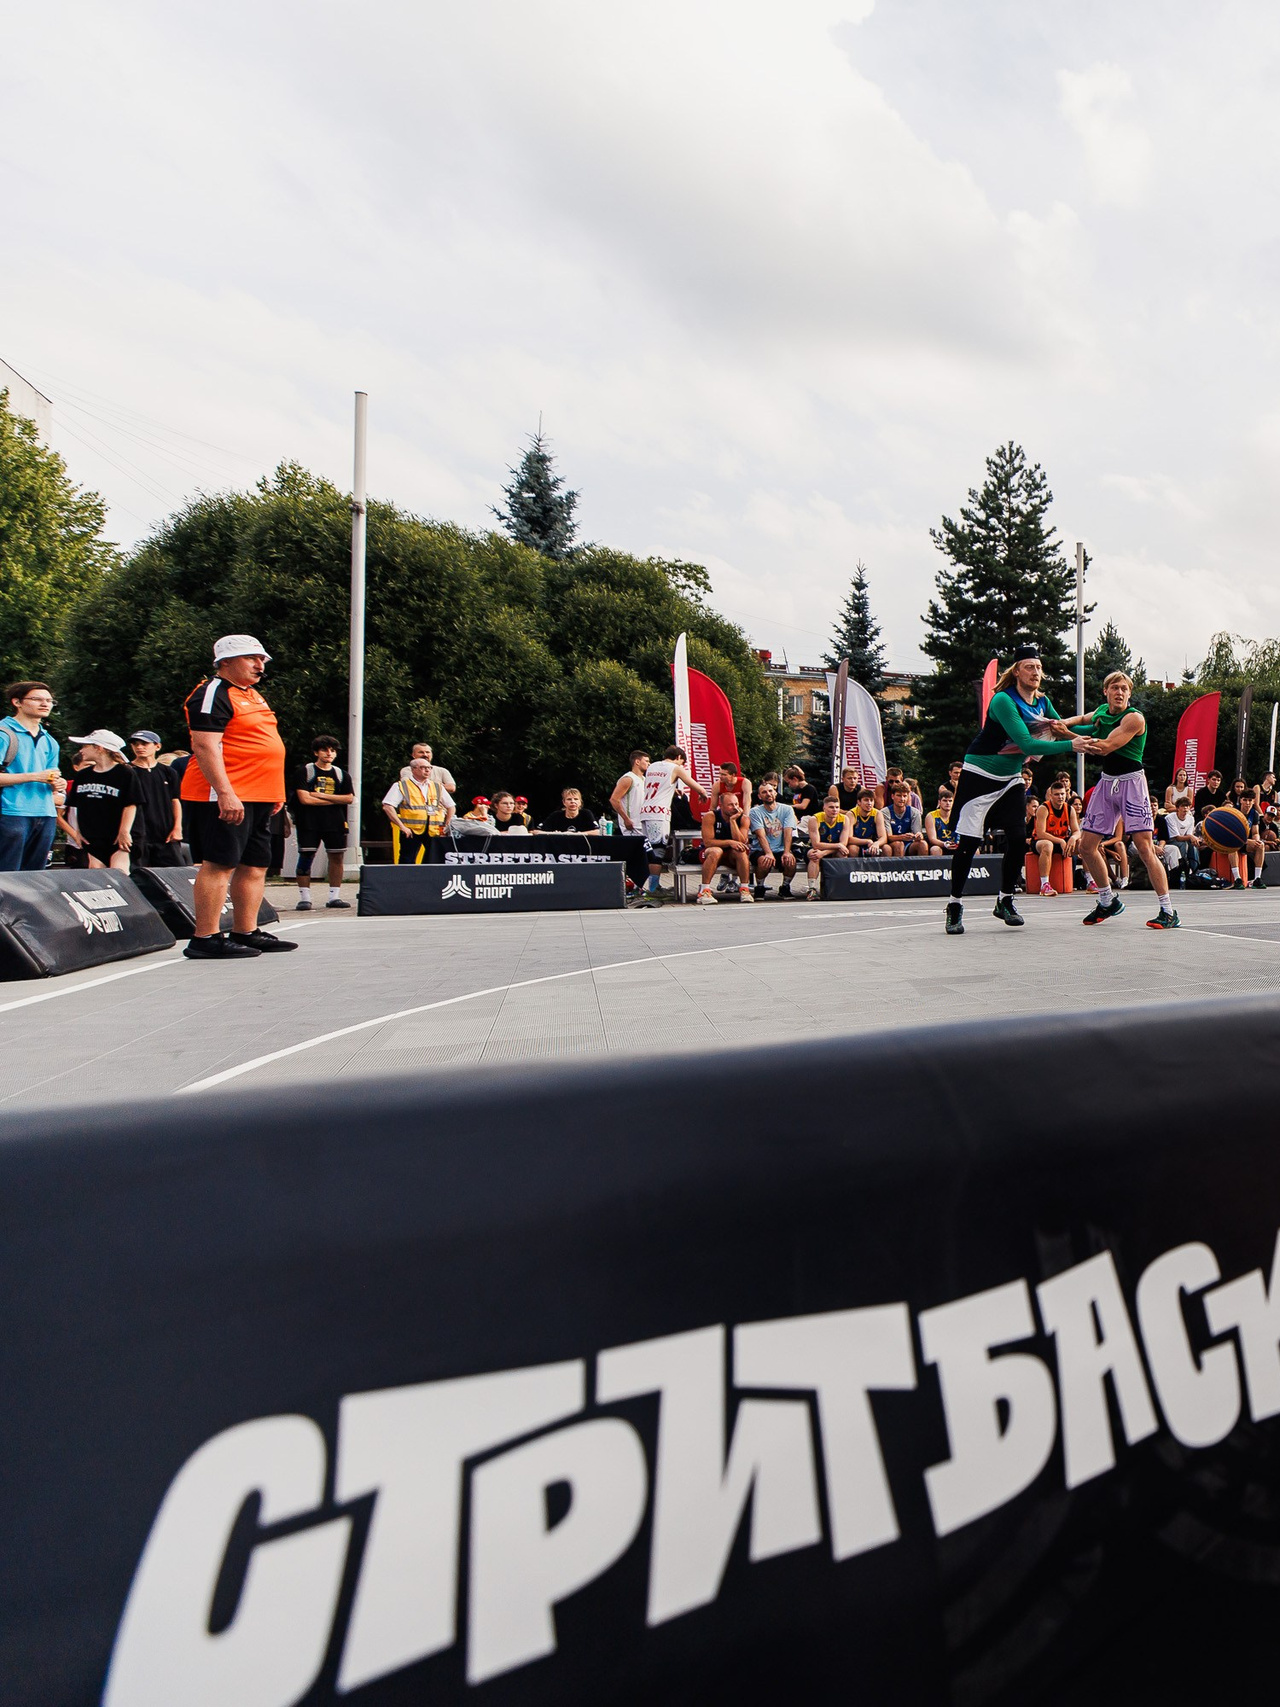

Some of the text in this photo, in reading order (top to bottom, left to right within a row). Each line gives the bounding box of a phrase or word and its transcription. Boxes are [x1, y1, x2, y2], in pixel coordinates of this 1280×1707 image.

[862, 763, 878, 792] ПОРТ
[76, 783, 120, 797] BROOKLYN
[861, 827, 868, 836] 7
[827, 834, 833, 843] 4
[475, 871, 555, 886] МОСКОВСКИЙ
[915, 869, 943, 882] ТУР
[475, 886, 513, 899] СПОРТ
